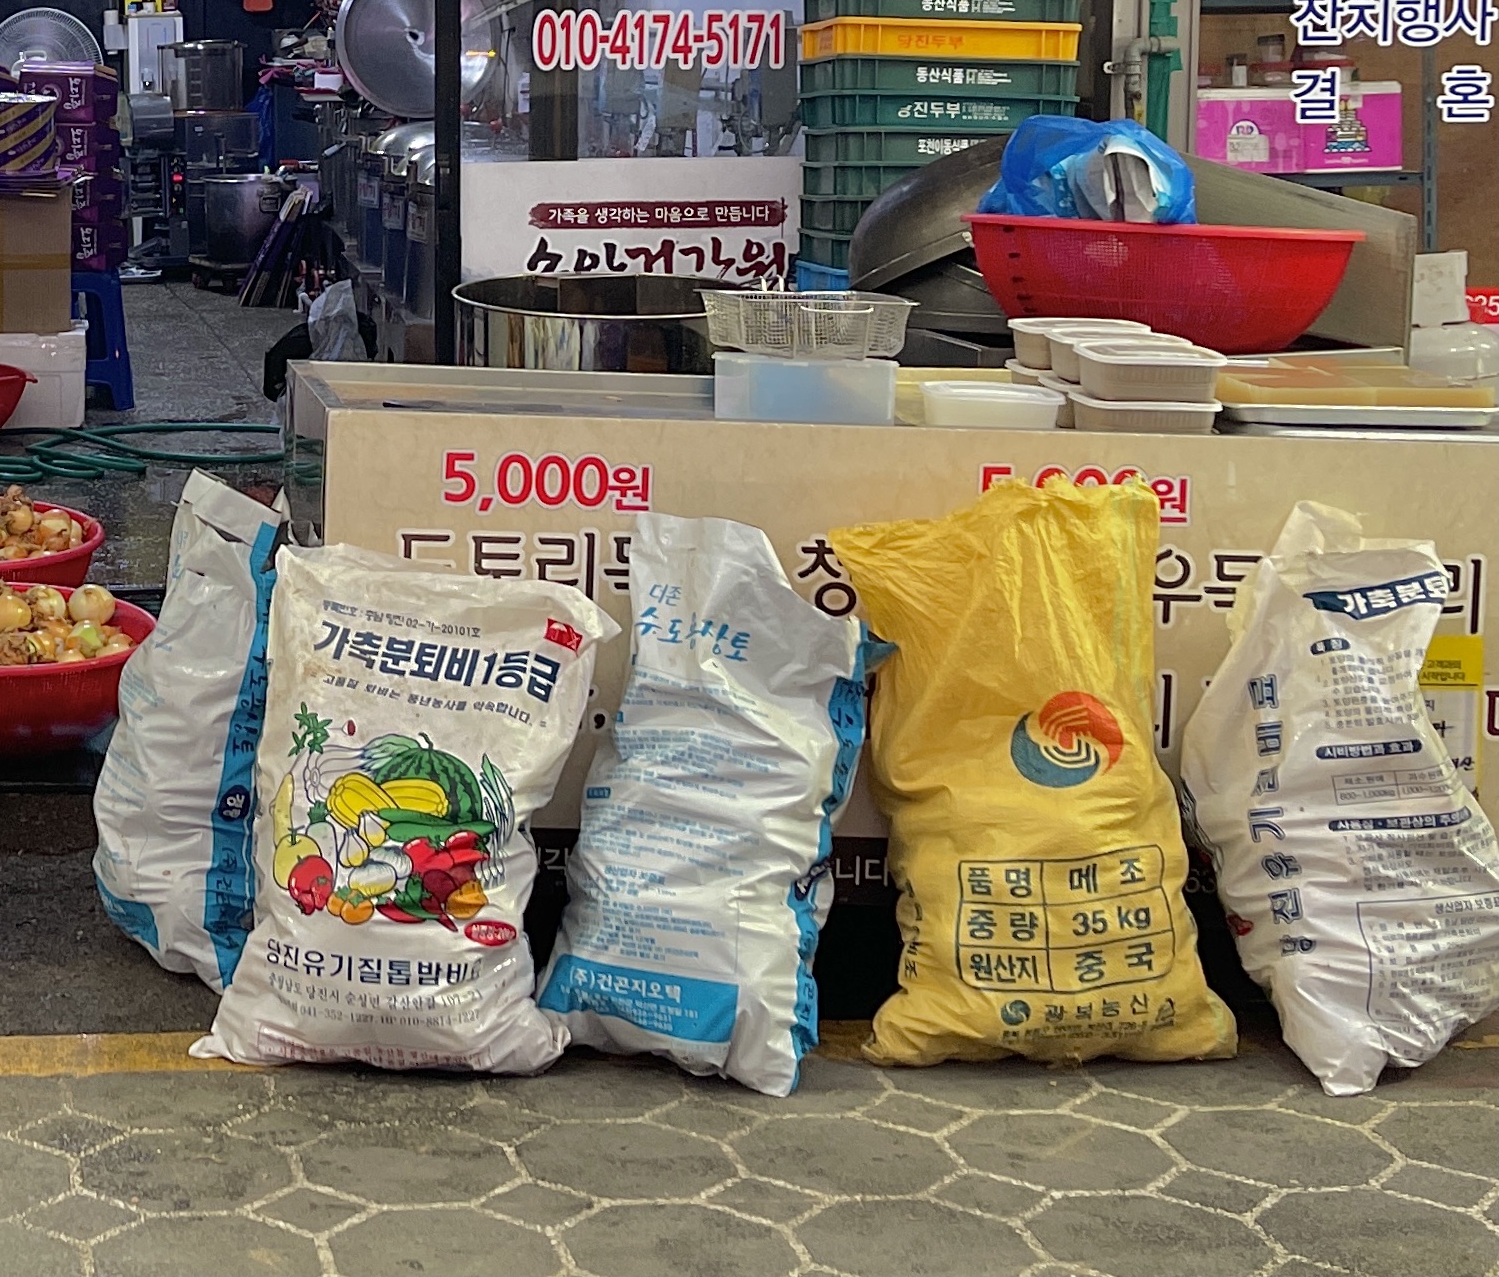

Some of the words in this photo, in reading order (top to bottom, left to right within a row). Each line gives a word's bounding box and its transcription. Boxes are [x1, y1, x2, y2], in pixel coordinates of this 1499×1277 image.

[533, 10, 785, 70] 010-4174-5171
[915, 67, 965, 84] 동산식품
[549, 207, 589, 225] 가족을
[595, 205, 650, 224] 생각하는
[655, 206, 710, 223] 마음으로
[715, 205, 770, 223] 만듭니다
[441, 450, 653, 513] 5,000원
[314, 621, 561, 703] 가축분퇴비1등급
[969, 953, 1040, 984] 원산지
[306, 981, 340, 1003] 당진시
